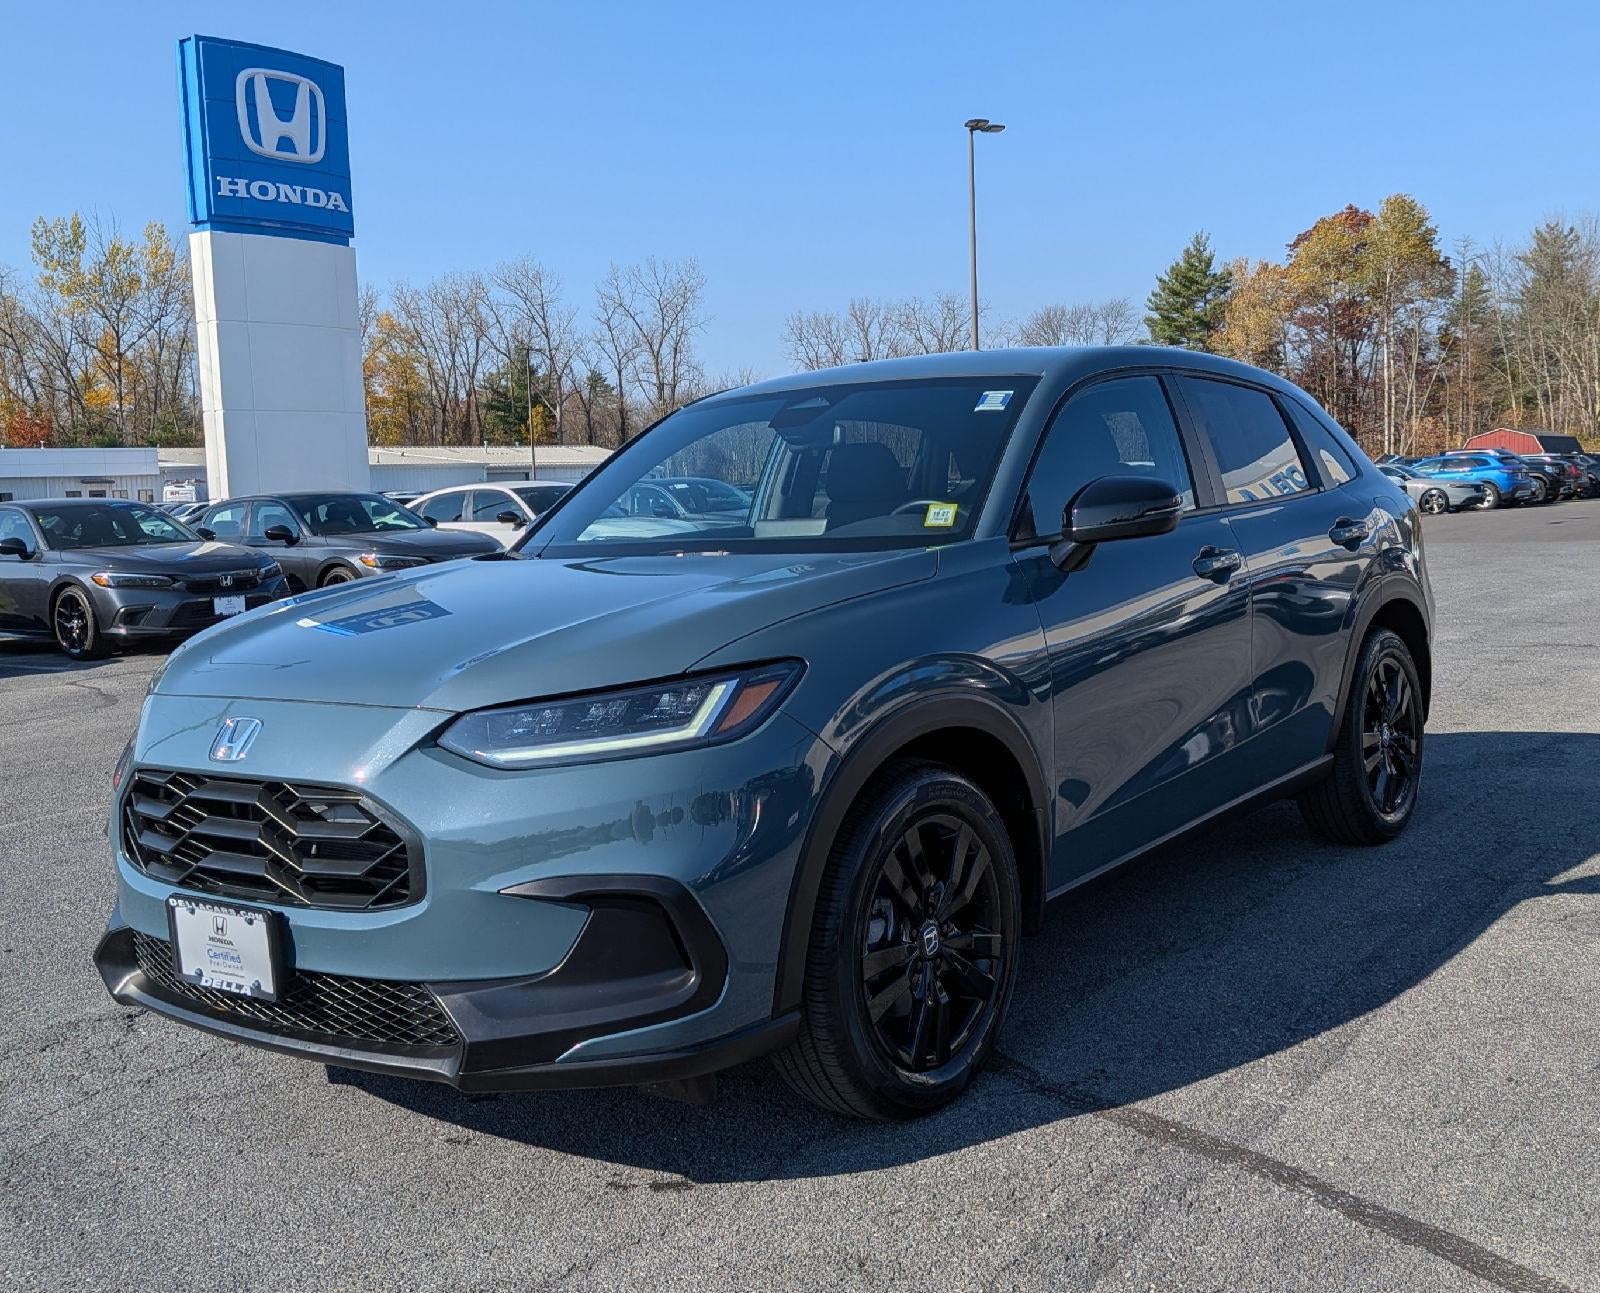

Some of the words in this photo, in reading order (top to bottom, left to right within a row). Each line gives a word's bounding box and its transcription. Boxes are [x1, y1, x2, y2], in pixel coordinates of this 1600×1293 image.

[216, 176, 350, 213] HONDA
[208, 936, 234, 946] HONDA
[207, 948, 241, 963] Certified
[200, 977, 252, 996] DELLA
